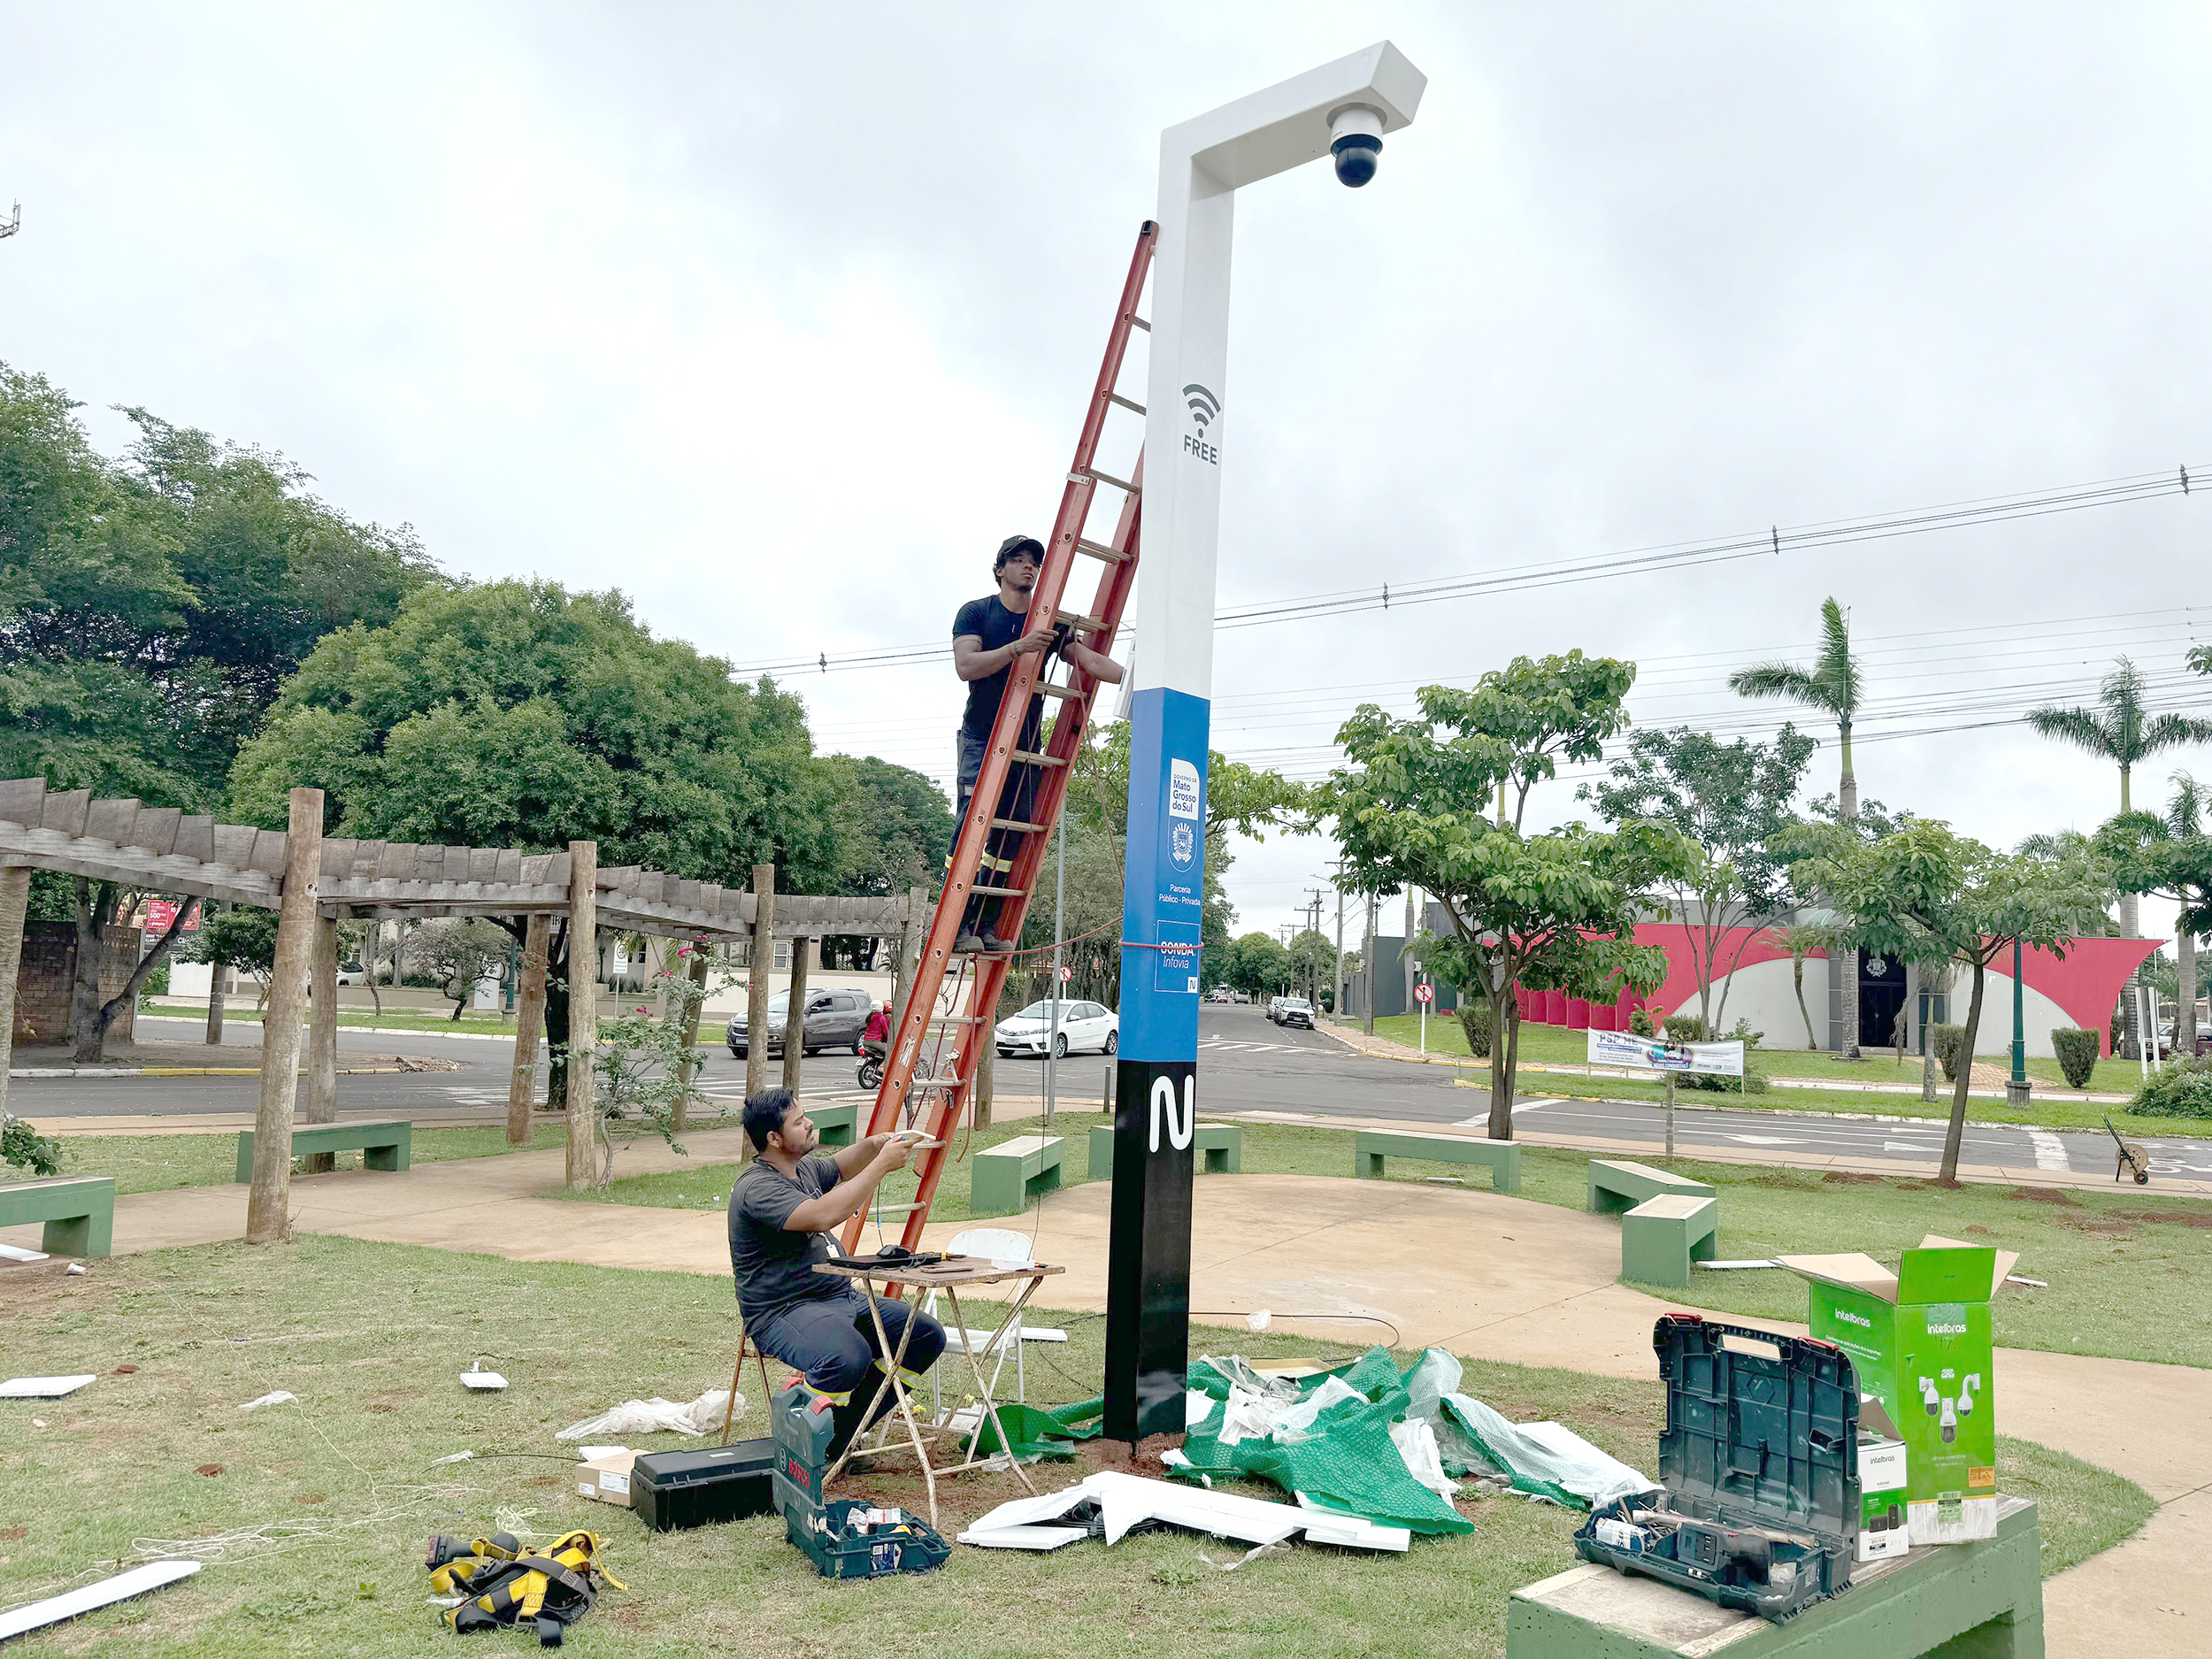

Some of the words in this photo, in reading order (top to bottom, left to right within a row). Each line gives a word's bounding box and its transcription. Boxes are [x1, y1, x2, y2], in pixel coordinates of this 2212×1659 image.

[1183, 434, 1217, 465] FREE
[1173, 773, 1192, 782] GOVERNO
[1173, 780, 1191, 792] Mato
[1172, 789, 1196, 803] Grosso
[1172, 800, 1181, 810] do
[1182, 802, 1193, 813] Sul
[1170, 883, 1191, 895] Parceria
[1158, 893, 1179, 903] Público
[1181, 895, 1201, 906] Privada
[1160, 941, 1194, 956] SONDA
[1163, 956, 1189, 969] Infovia
[1834, 1308, 1871, 1328] intelbras
[1927, 1323, 1967, 1334] intelbras
[1870, 1455, 1895, 1465] intelbras
[787, 1456, 810, 1489] BOSCH
